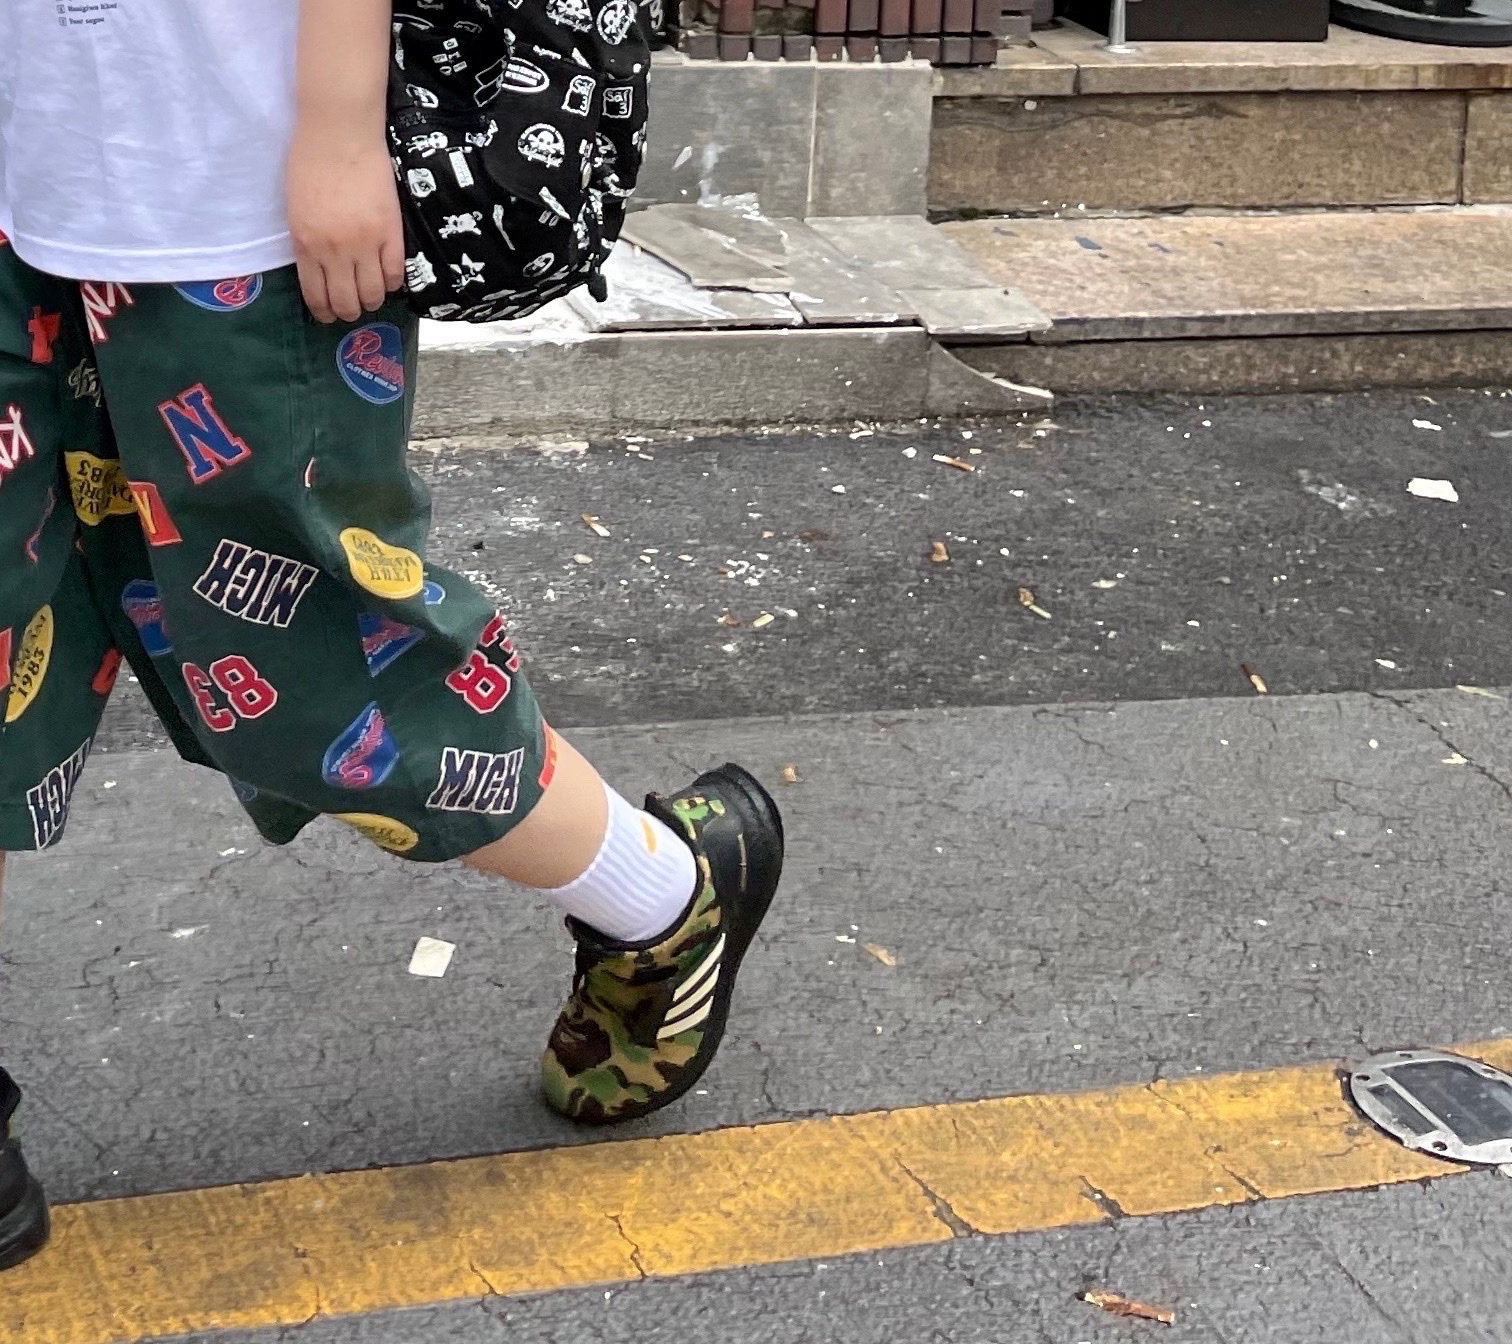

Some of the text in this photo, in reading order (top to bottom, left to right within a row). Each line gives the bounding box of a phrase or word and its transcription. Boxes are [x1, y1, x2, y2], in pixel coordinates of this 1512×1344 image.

[158, 382, 253, 485] N
[193, 538, 319, 628] MICH
[425, 746, 526, 815] MICH
